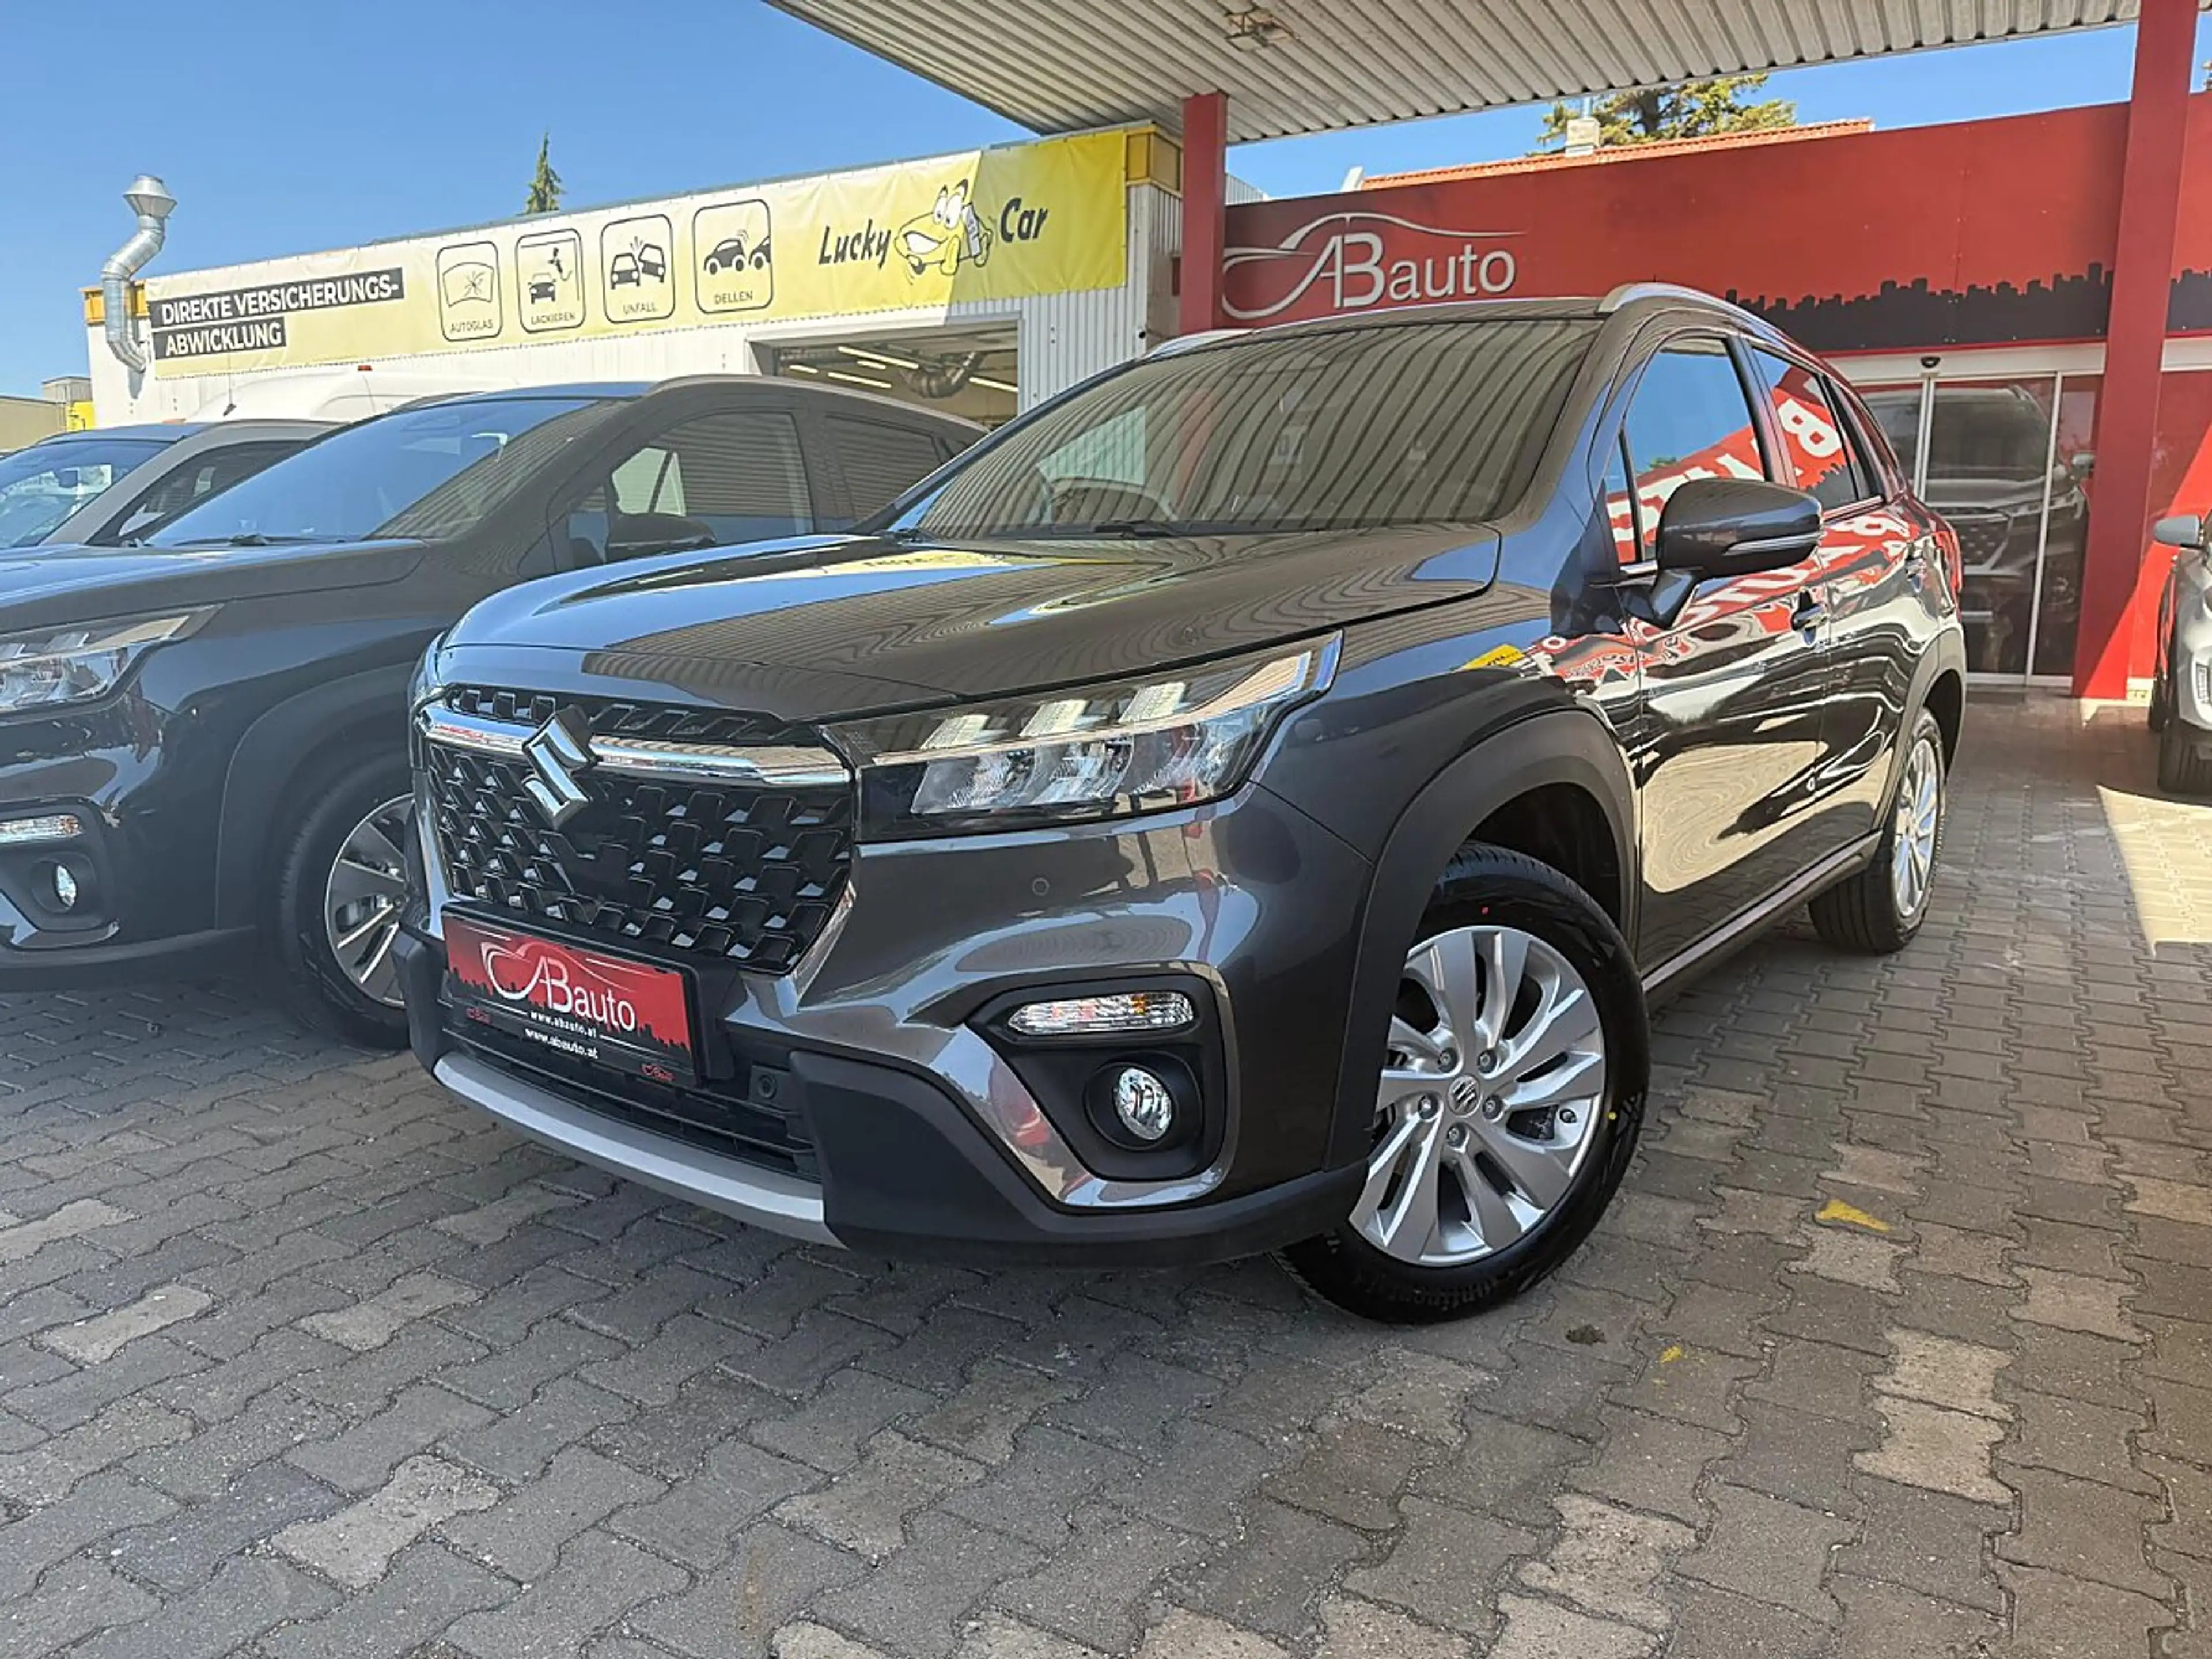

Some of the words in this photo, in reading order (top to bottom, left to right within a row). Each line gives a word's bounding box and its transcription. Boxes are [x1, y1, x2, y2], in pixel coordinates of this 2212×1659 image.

[818, 224, 891, 270] Lucky
[1000, 196, 1048, 243] Car
[161, 297, 231, 324] DIREKTE
[233, 274, 400, 316] VERSICHERUNGS-
[623, 301, 660, 315] UNFALL
[714, 290, 753, 305] DELLEN
[450, 318, 494, 334] AUTOGLAS
[531, 311, 576, 325] LACKIEREN
[165, 323, 283, 357] ABWICKLUNG
[524, 1028, 599, 1059] www.abauto.at
